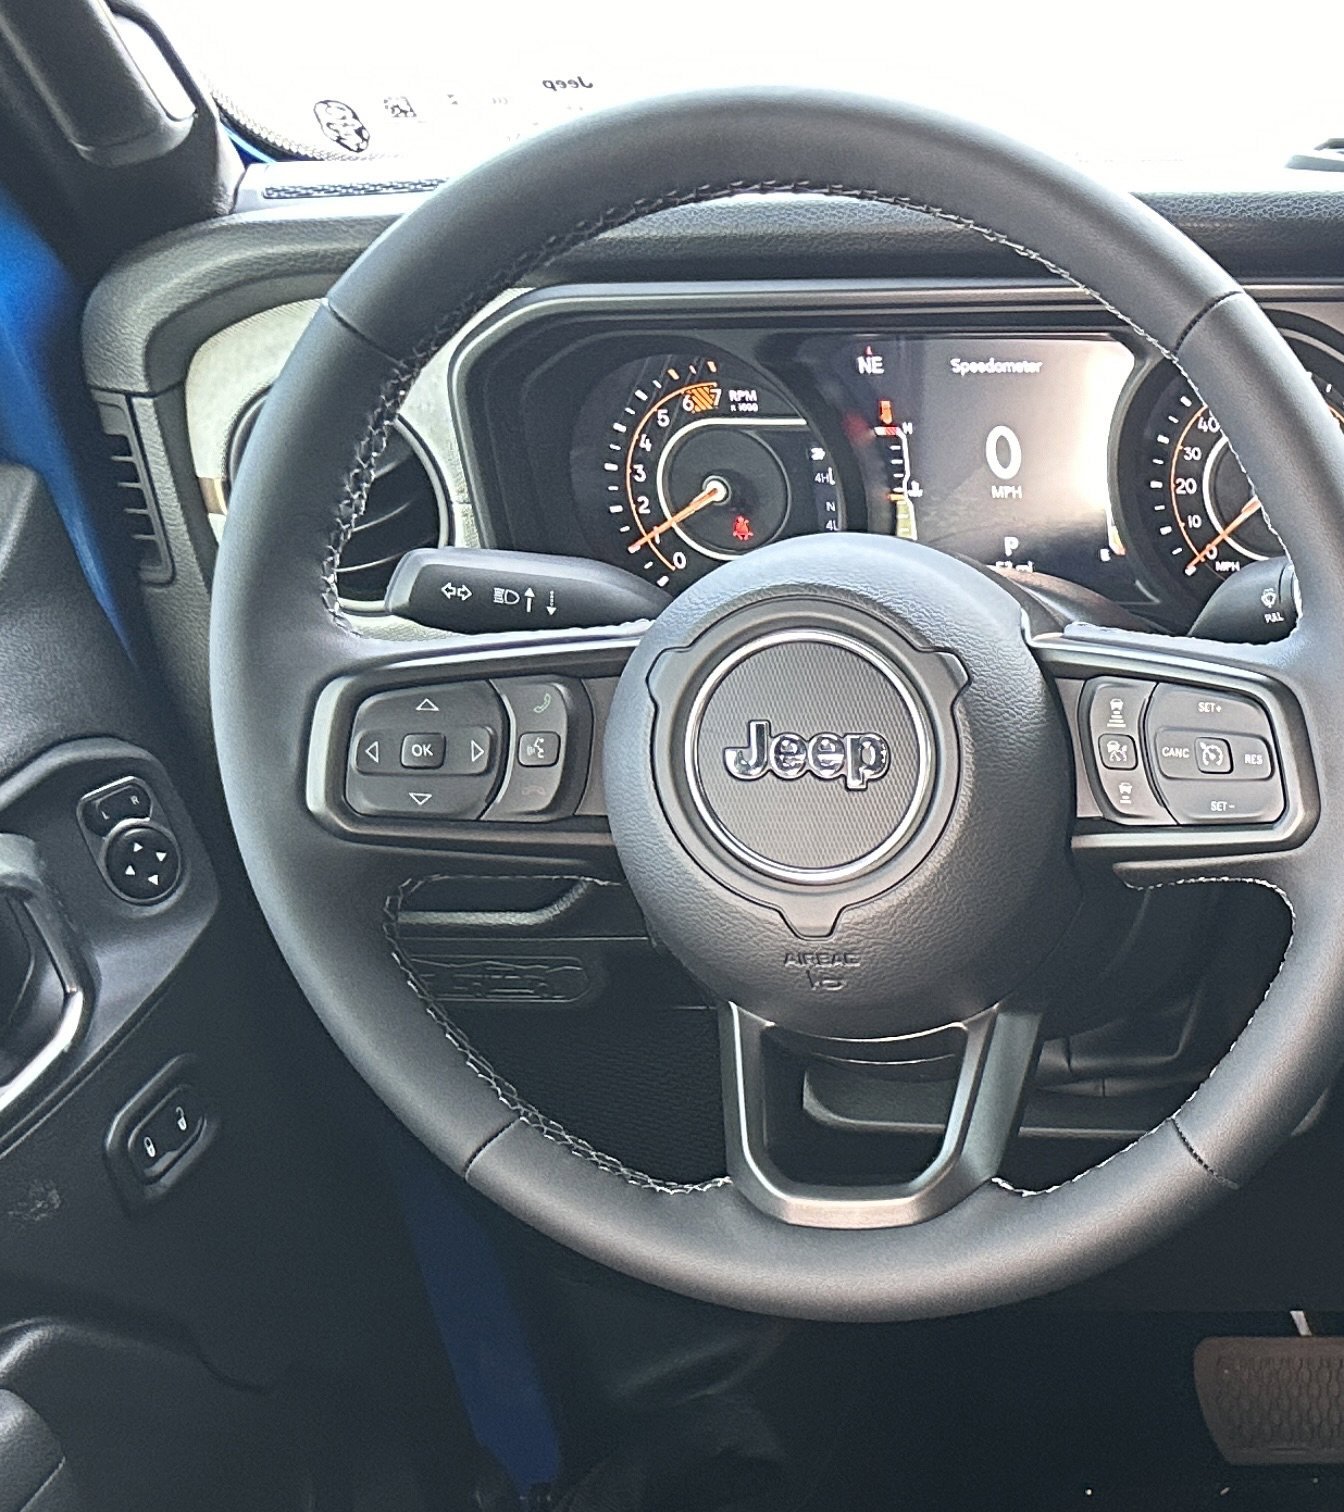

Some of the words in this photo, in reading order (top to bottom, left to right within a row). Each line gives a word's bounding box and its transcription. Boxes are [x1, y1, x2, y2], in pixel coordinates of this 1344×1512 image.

[857, 357, 884, 374] NE
[950, 358, 1043, 375] Speedometer
[729, 390, 757, 402] RPM
[657, 409, 670, 428] 5
[1197, 416, 1220, 434] 40
[639, 436, 652, 452] 4
[985, 424, 1022, 479] 0
[1184, 447, 1202, 461] 30
[633, 464, 646, 481] 3
[991, 485, 1023, 500] MPH
[1176, 478, 1197, 495] 20
[637, 497, 650, 514] 2
[1187, 514, 1202, 529] 10
[1004, 536, 1019, 557] P
[1206, 545, 1218, 560] 0
[673, 552, 686, 569] 0
[1216, 561, 1241, 572] MPH
[411, 745, 434, 757] OK
[724, 720, 891, 790] Jeep
[1162, 747, 1190, 759] CANC
[1244, 754, 1263, 765] RES
